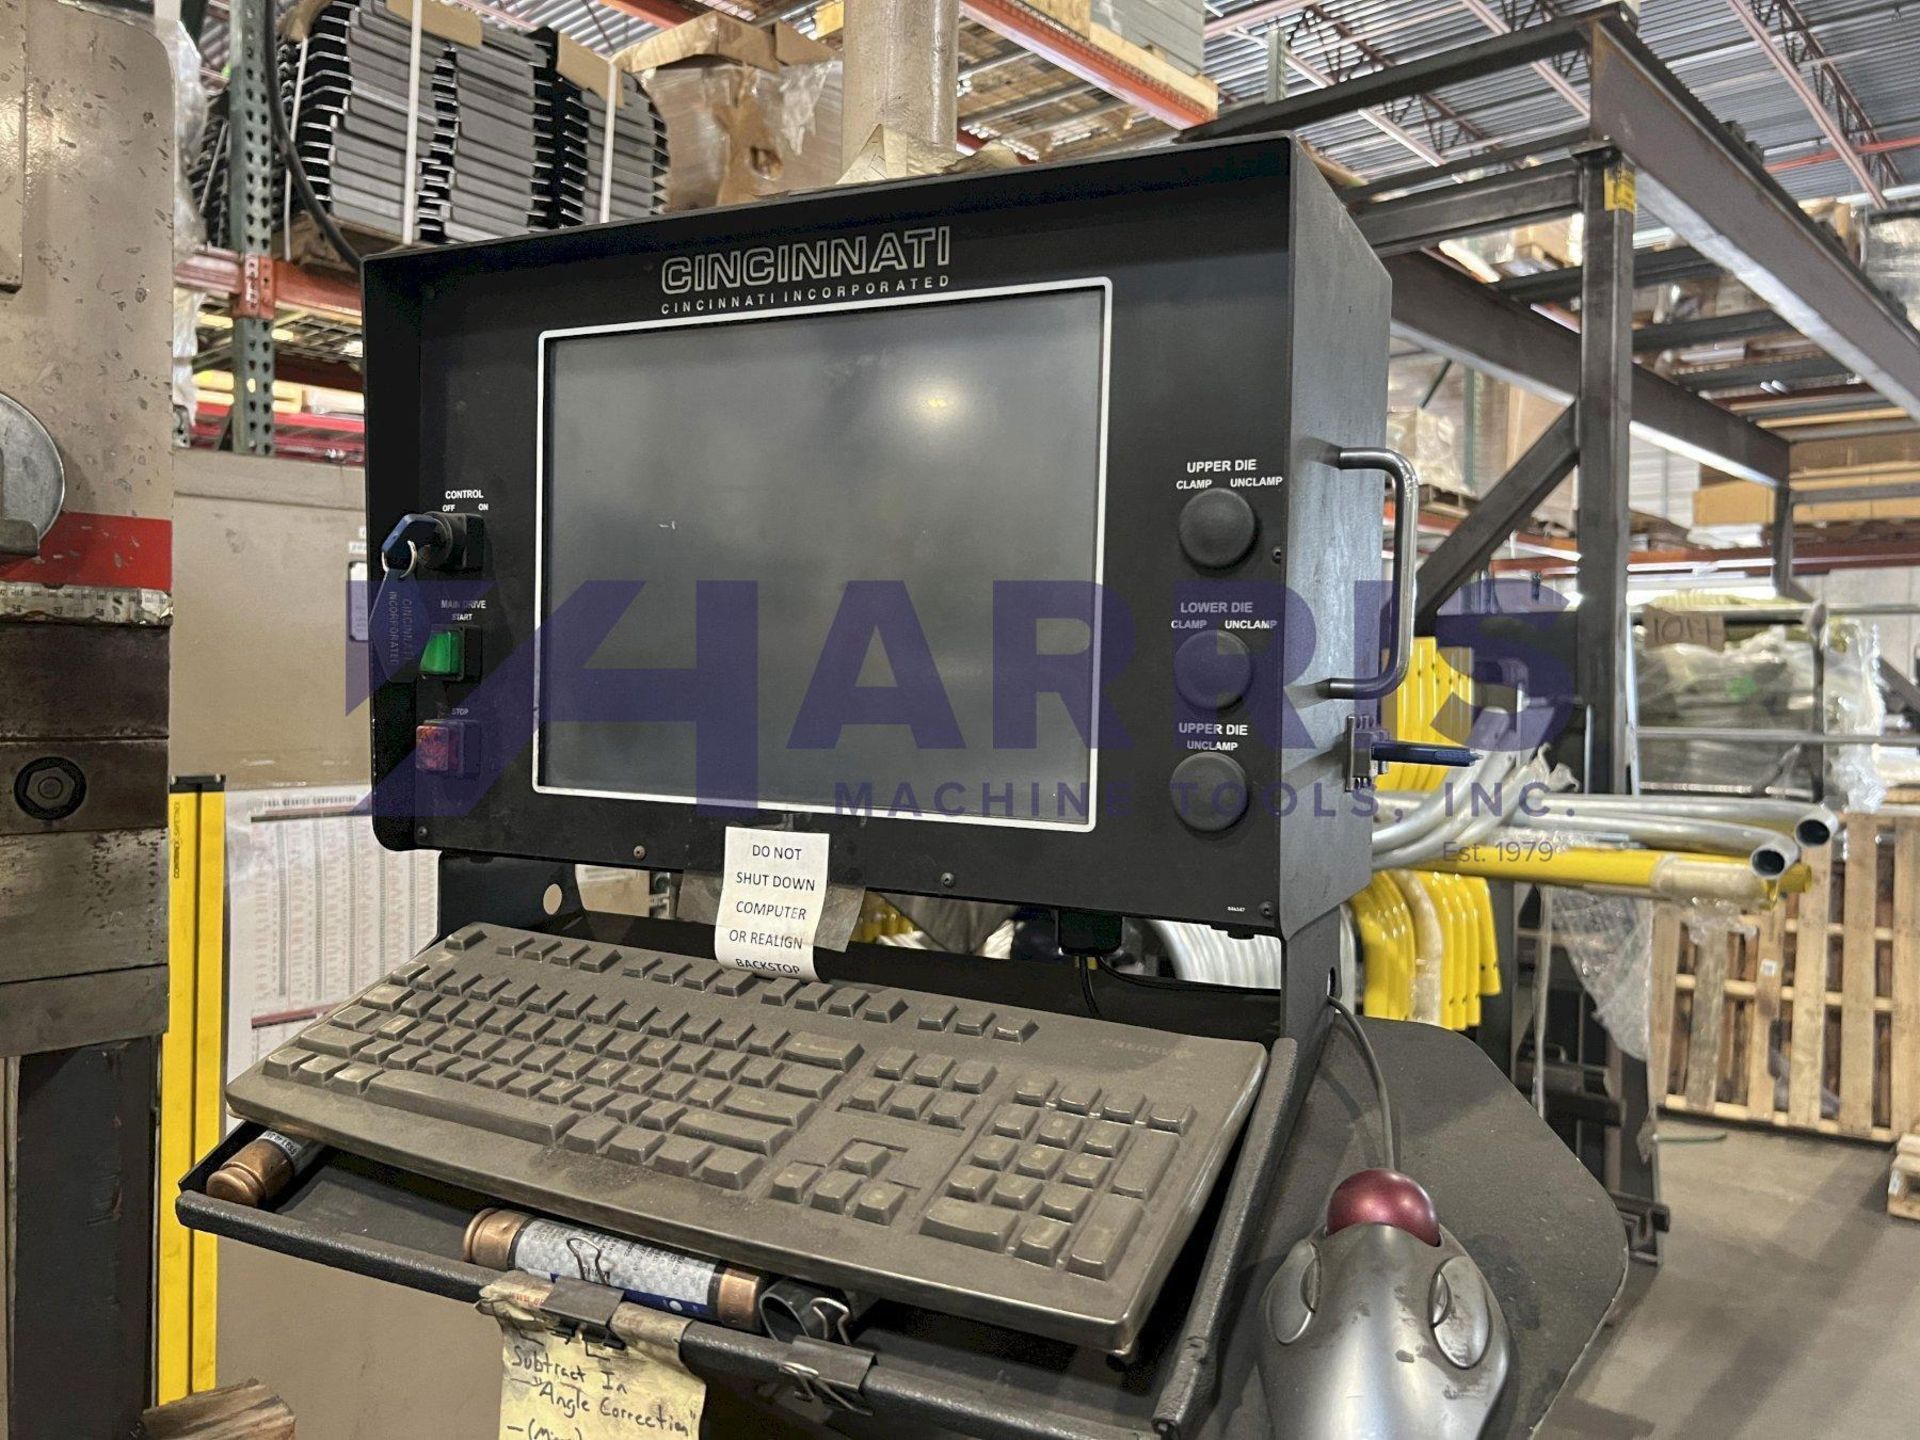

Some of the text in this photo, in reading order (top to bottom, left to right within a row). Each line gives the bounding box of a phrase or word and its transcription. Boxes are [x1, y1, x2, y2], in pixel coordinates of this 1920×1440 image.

[661, 226, 950, 295] CINCINNATI
[661, 274, 950, 315] CINCINNATI INCORPORATED
[1186, 459, 1257, 474] UPPER DIE
[1176, 476, 1283, 490] CLAMP UNCLAMP
[445, 489, 485, 500] CONTROL
[442, 503, 489, 512] OFF ON
[1180, 602, 1253, 614] LOWER DIE
[451, 613, 473, 621] START
[1171, 620, 1278, 630] CLAMP UNCLAMP
[451, 707, 469, 716] STOP
[1178, 722, 1248, 736] UPPER DIE
[1186, 740, 1239, 751] UNCLAMP
[752, 844, 803, 861] DO NOT
[736, 871, 816, 892] SHUT DOWN
[736, 900, 807, 920] COMPUTER
[729, 929, 803, 950] OR REALIGN
[735, 958, 800, 975] BACKSTOP
[512, 1345, 628, 1395] Subtract In
